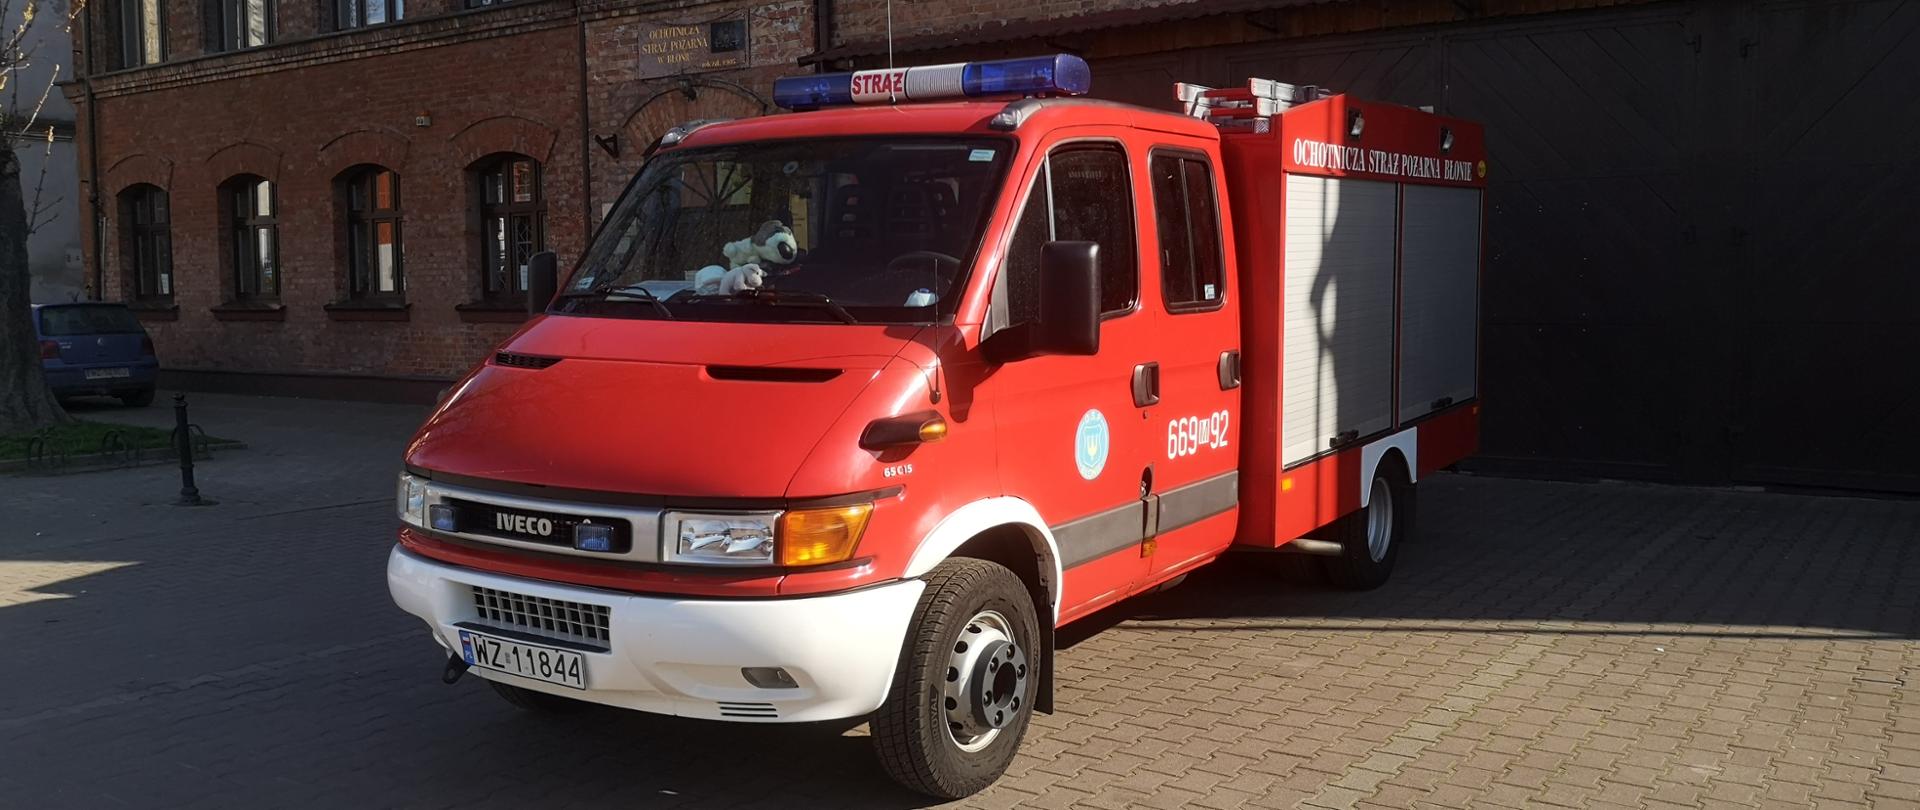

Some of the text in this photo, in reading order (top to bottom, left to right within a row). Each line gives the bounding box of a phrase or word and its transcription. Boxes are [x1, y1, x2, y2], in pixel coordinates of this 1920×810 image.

[1293, 138, 1366, 172] OCHOTNICZA
[1444, 160, 1473, 181] BŁONIE
[496, 512, 552, 536] IVECO
[473, 636, 581, 685] WZ 11844
